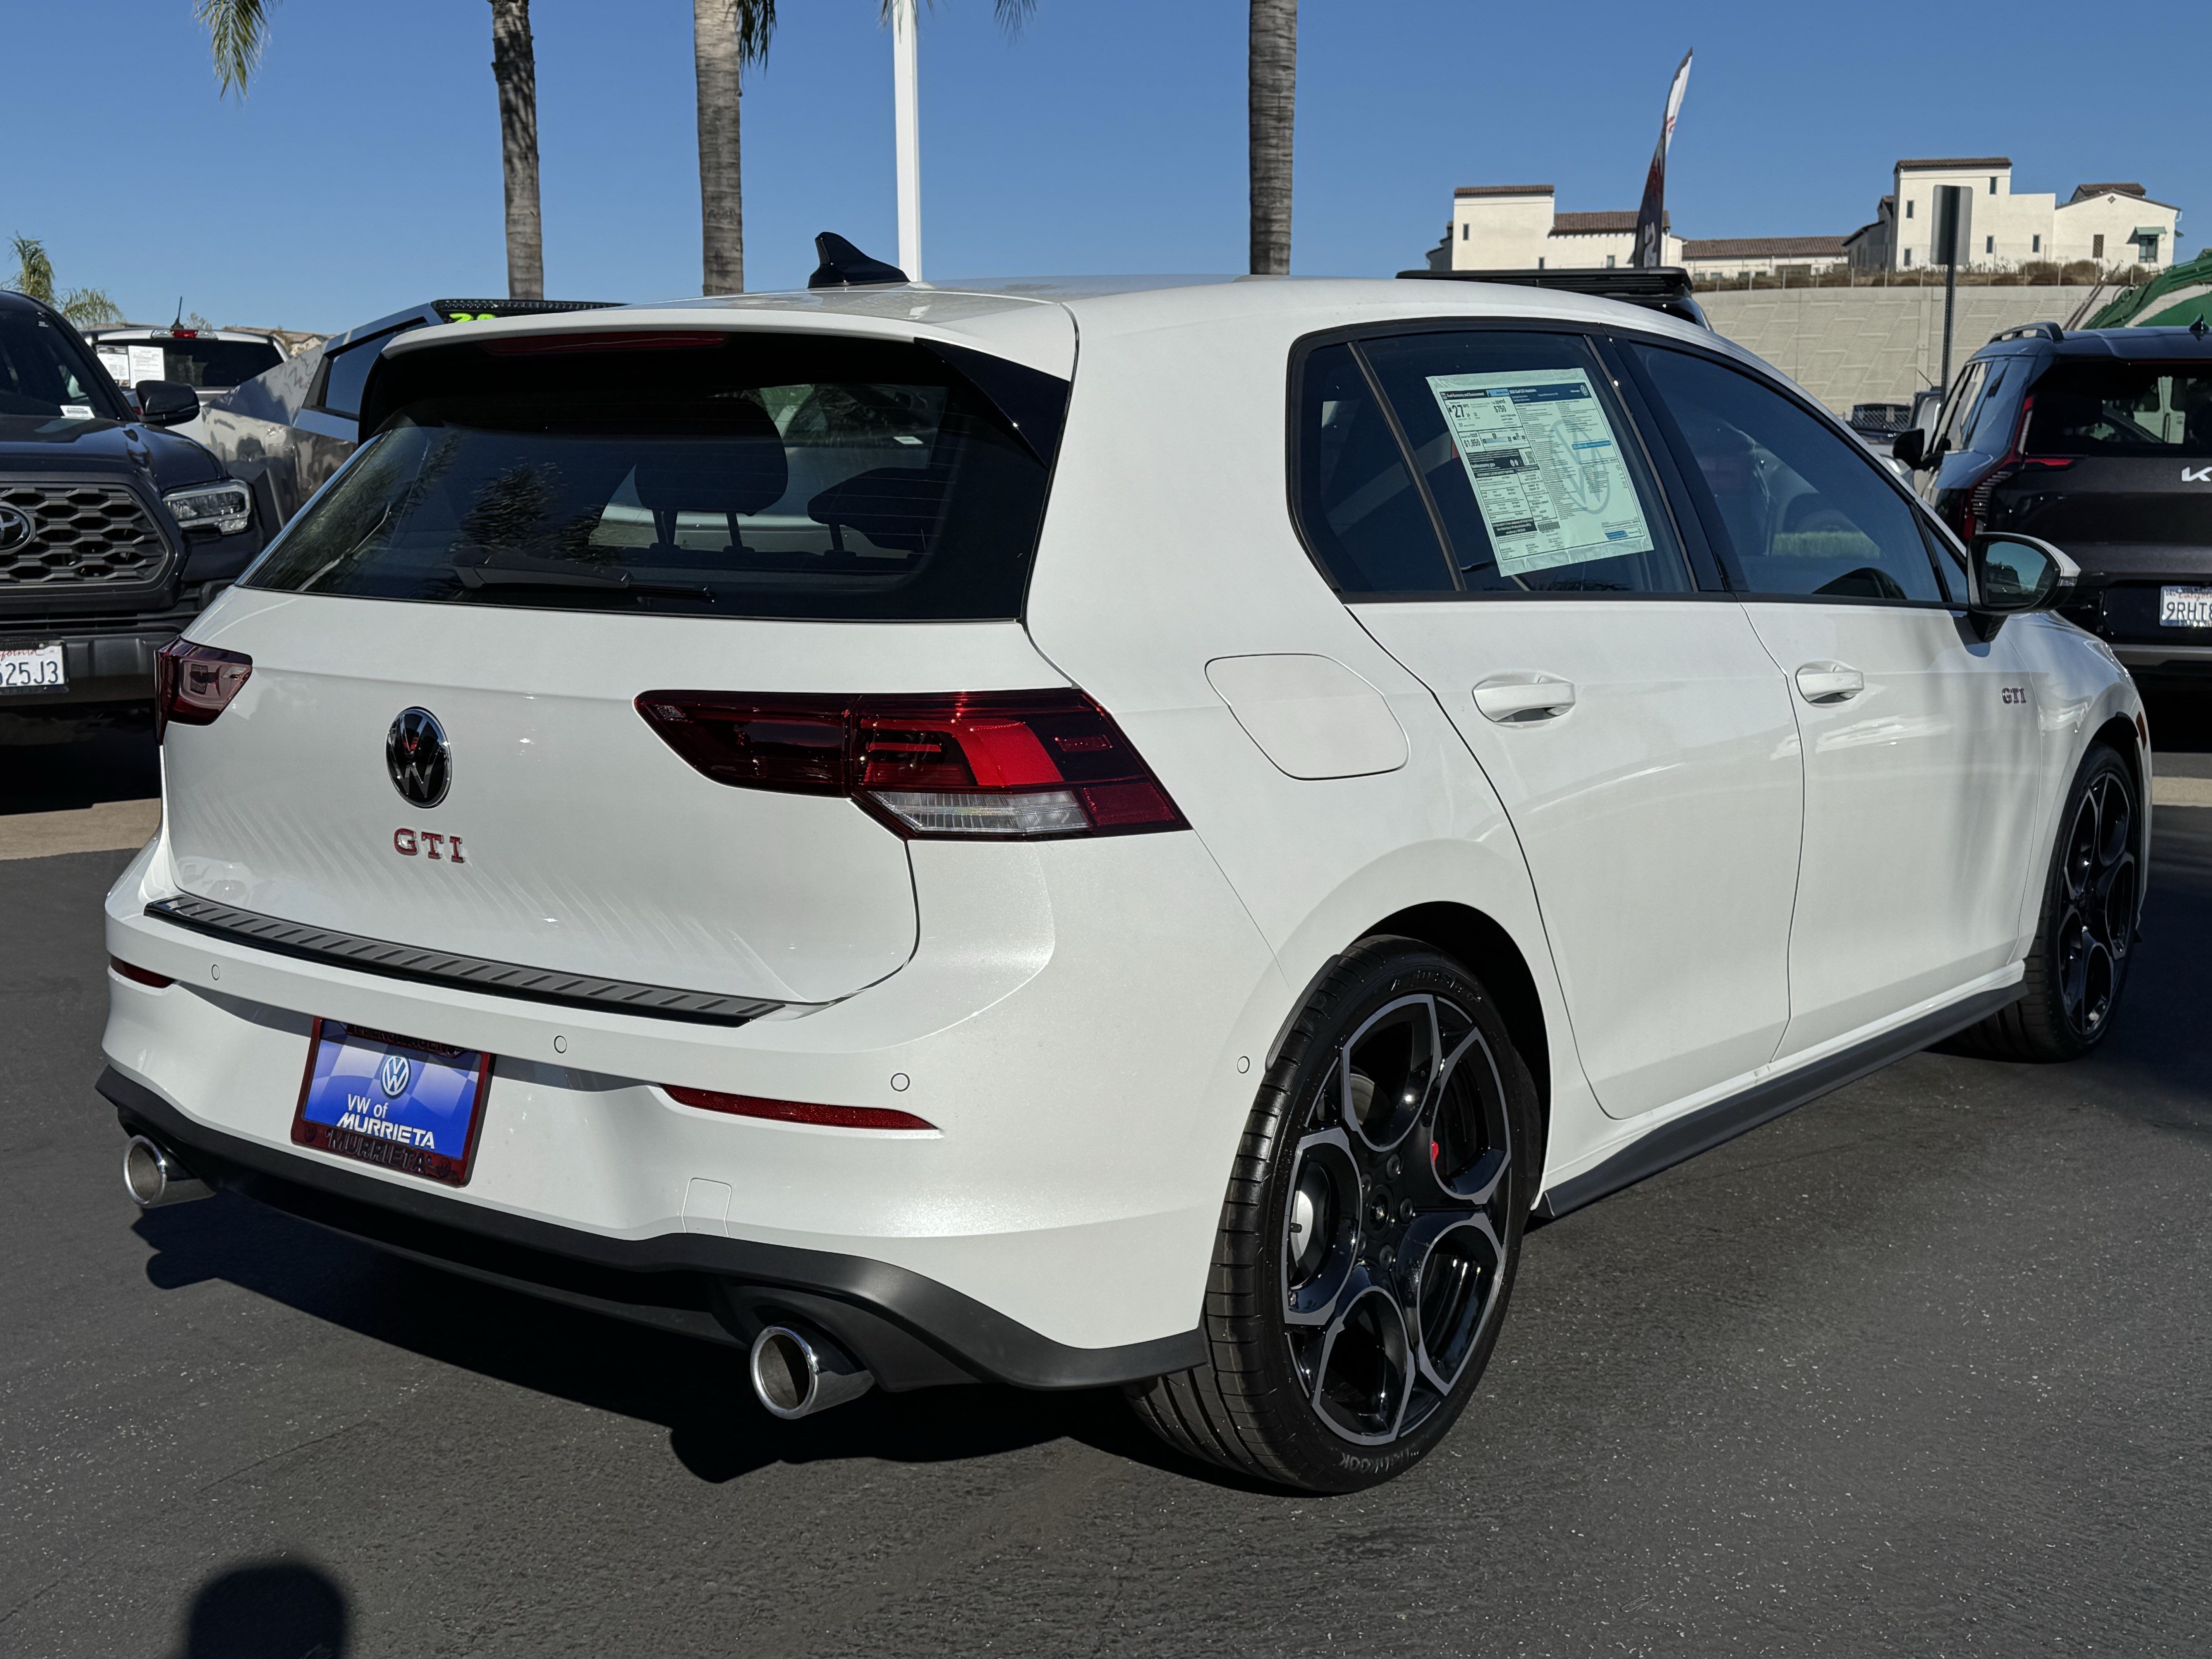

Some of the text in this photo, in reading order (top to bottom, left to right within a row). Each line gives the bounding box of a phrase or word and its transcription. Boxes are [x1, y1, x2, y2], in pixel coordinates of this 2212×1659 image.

[1452, 404, 1465, 418] 27
[0, 661, 58, 686] 25J3
[2001, 687, 2026, 704] GTI
[394, 828, 465, 864] GTI
[348, 1094, 388, 1119] VW of
[336, 1112, 435, 1149] MURRIETA
[328, 1128, 426, 1174] MURRIETA
